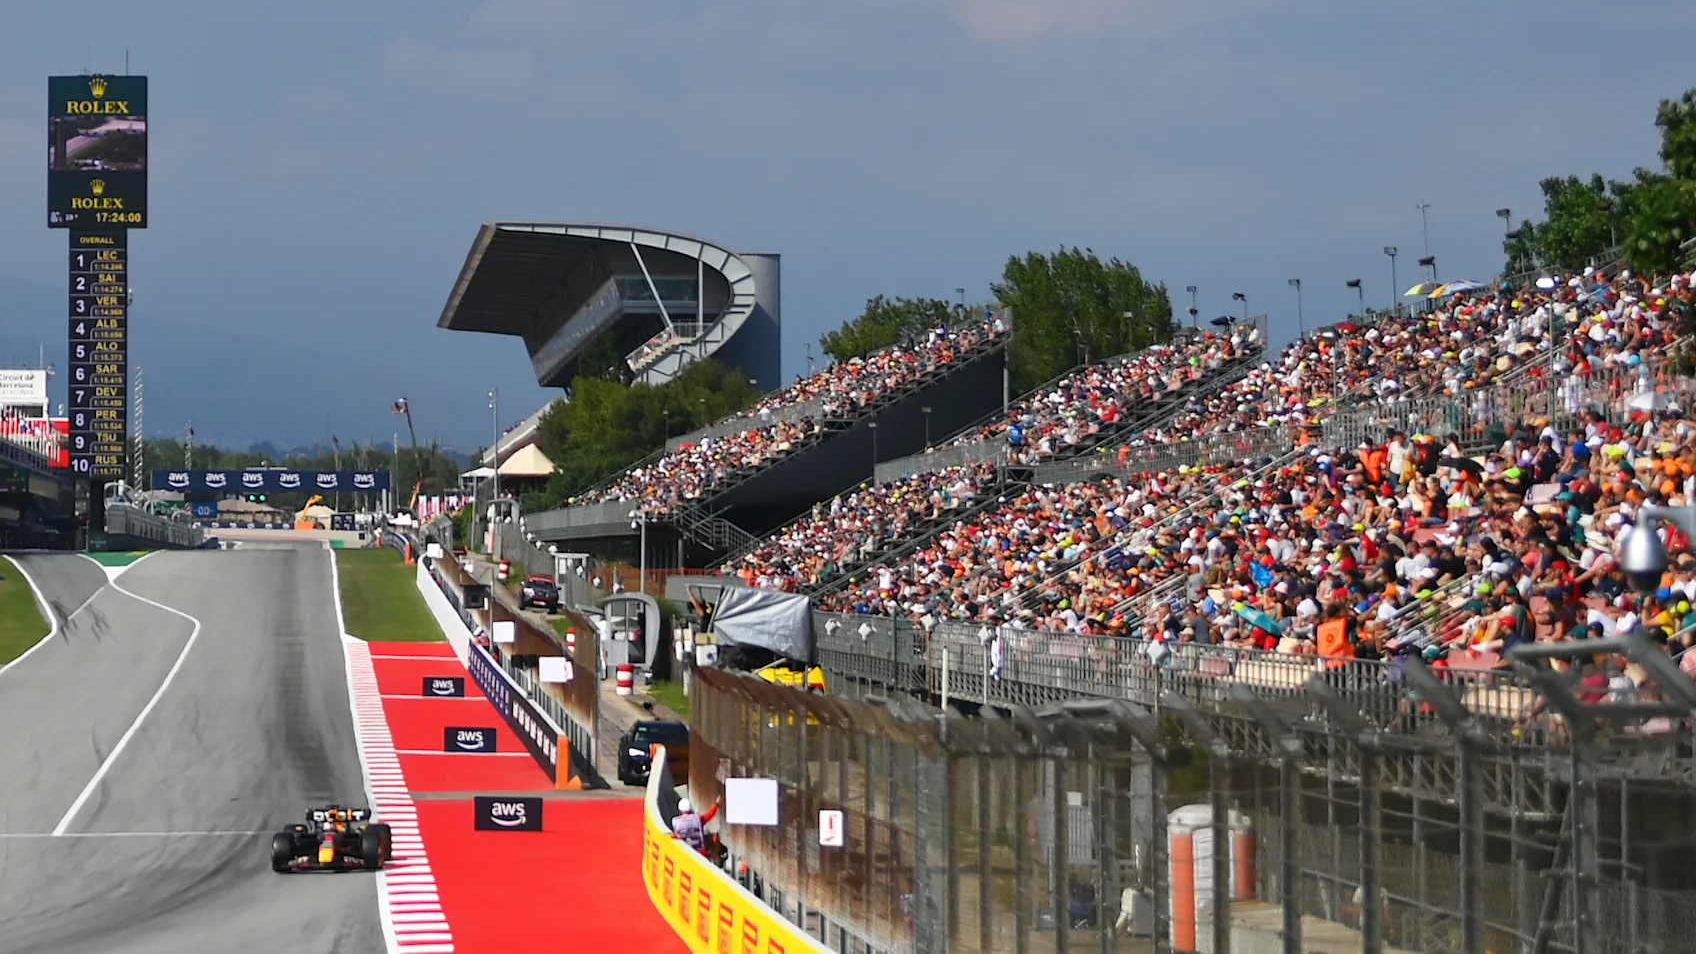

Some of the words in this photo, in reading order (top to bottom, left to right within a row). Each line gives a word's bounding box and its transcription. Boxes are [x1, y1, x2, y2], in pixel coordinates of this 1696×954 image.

[66, 101, 129, 114] ROLEX
[71, 197, 124, 209] ROLEX
[95, 212, 142, 222] 17:24:00
[79, 236, 115, 244] OVERALL
[76, 254, 84, 267] 1
[97, 251, 117, 260] LEC
[76, 277, 85, 290] 2
[98, 273, 116, 283] SAI
[76, 299, 85, 313] 3
[96, 296, 117, 305] VER
[75, 322, 85, 335] 4
[76, 345, 85, 358] 5
[95, 341, 118, 351] ALO
[75, 367, 84, 381] 6
[95, 364, 117, 373] SAR
[75, 390, 84, 403] 7
[95, 387, 117, 396] DEV
[75, 413, 84, 427] 8
[95, 410, 117, 419] PER
[75, 435, 84, 449] 9
[96, 433, 117, 442] TSU
[71, 458, 89, 472] 10
[95, 455, 117, 464] RUS
[168, 472, 189, 482] aws
[205, 472, 226, 482] aws
[242, 472, 263, 482] aws
[279, 473, 300, 482] aws
[316, 473, 337, 482] aws
[353, 473, 374, 483] aws
[432, 679, 454, 689] aws
[457, 730, 483, 741] aws
[491, 802, 526, 816] aws
